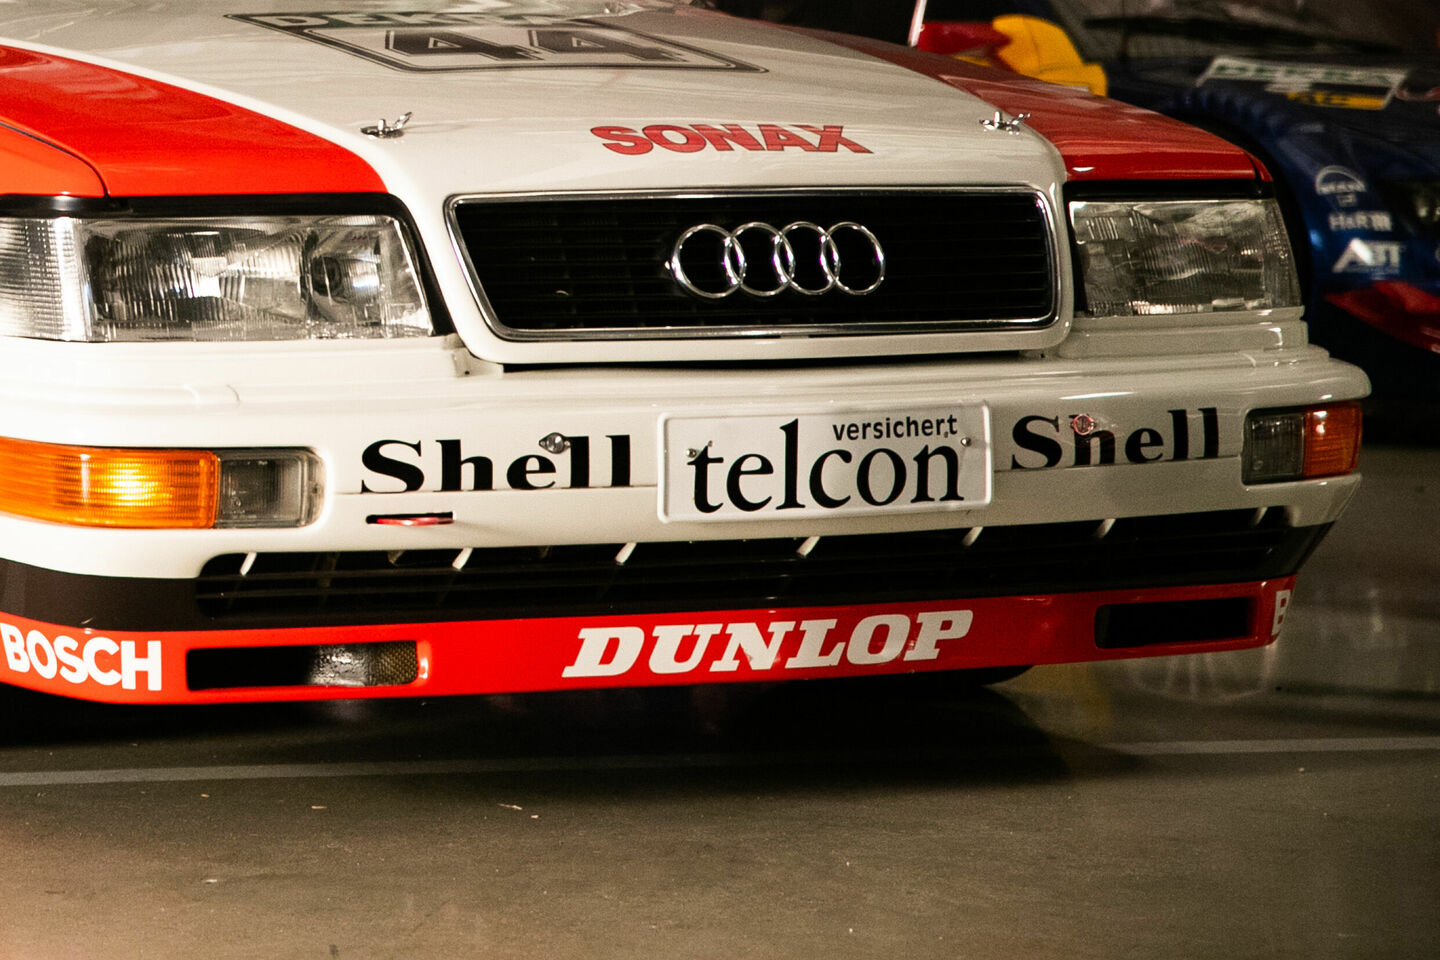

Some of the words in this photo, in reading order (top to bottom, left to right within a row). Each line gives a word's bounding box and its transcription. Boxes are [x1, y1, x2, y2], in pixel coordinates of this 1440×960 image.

[383, 28, 692, 61] 44
[590, 124, 873, 155] SONAX
[832, 414, 958, 441] versichert
[1011, 407, 1221, 470] Shell
[361, 434, 632, 492] Shell
[686, 418, 965, 513] telcon
[0, 622, 162, 691] BOSCH
[562, 610, 973, 677] DUNLOP
